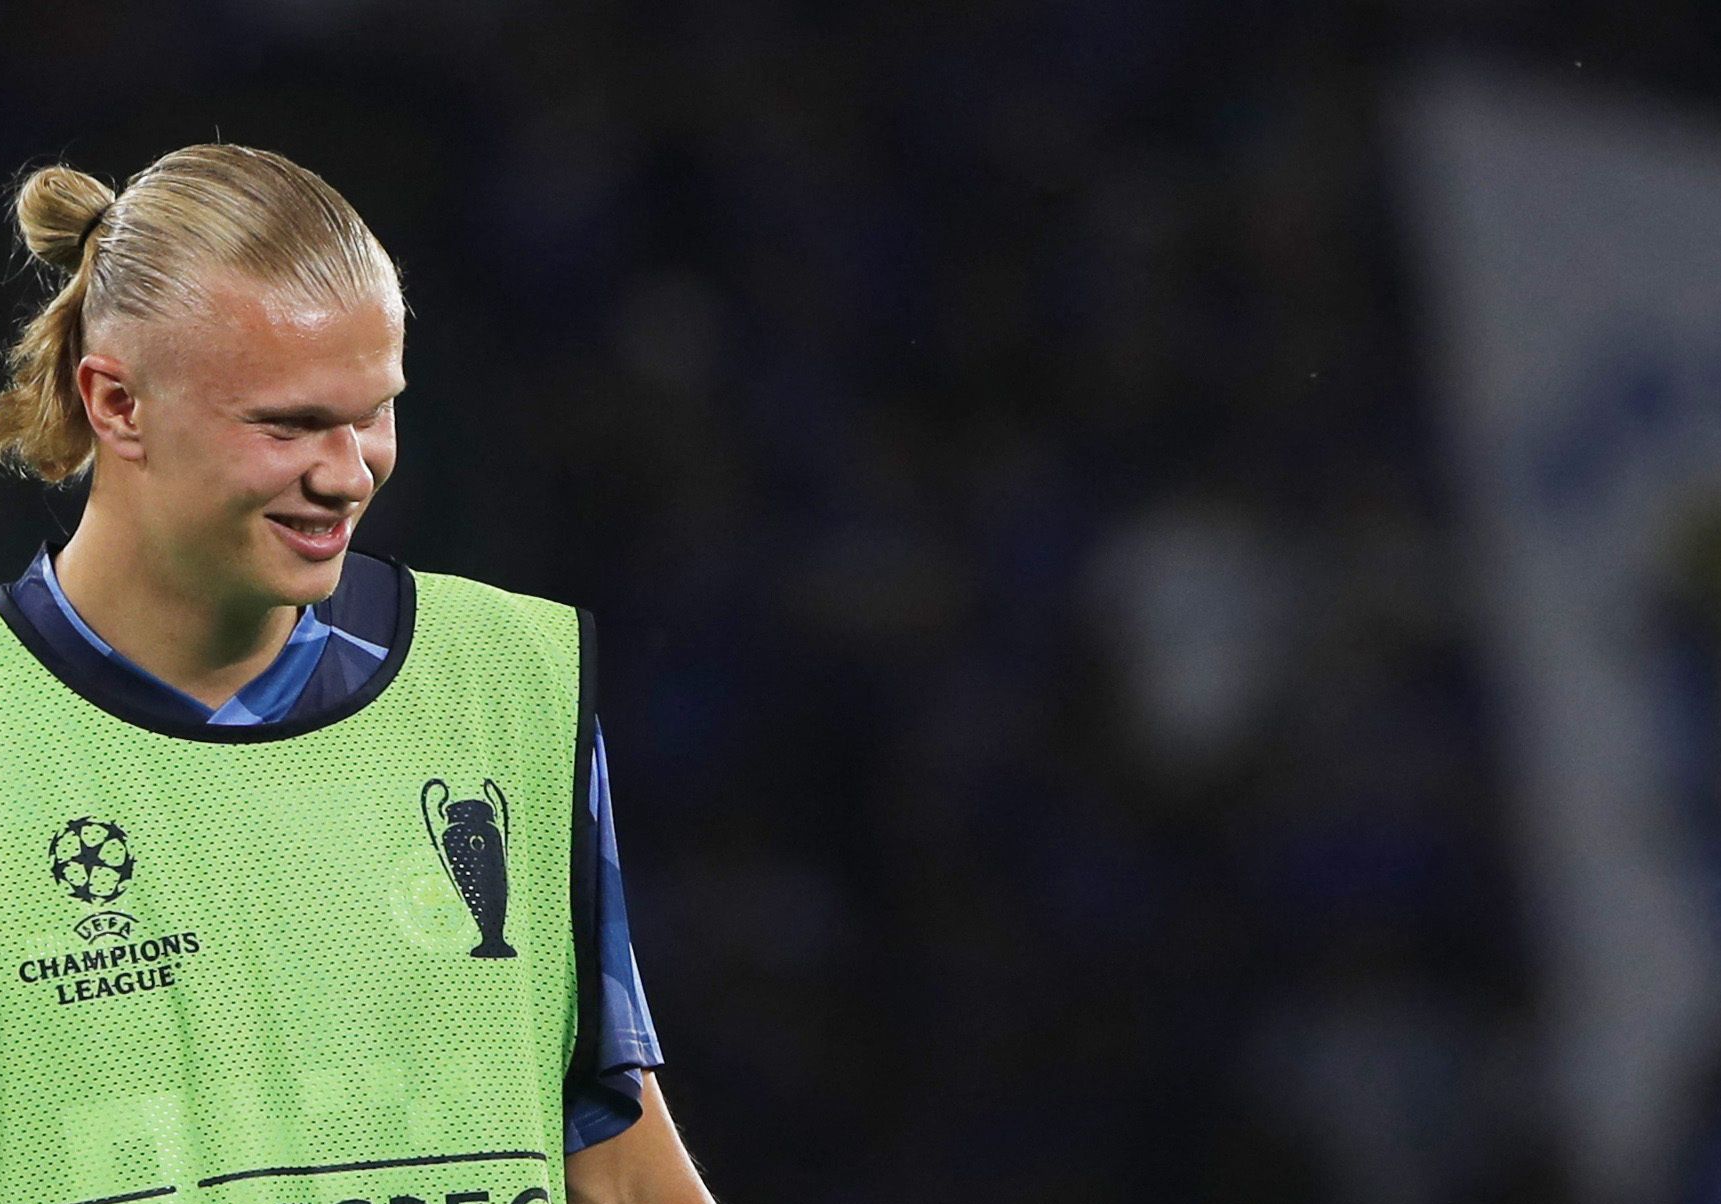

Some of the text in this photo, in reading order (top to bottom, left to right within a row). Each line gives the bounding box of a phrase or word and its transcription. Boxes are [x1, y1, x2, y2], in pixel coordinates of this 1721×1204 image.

[76, 916, 132, 941] UEFA
[18, 932, 200, 983] CHAMPIONS
[55, 963, 176, 1005] LEAGUE
